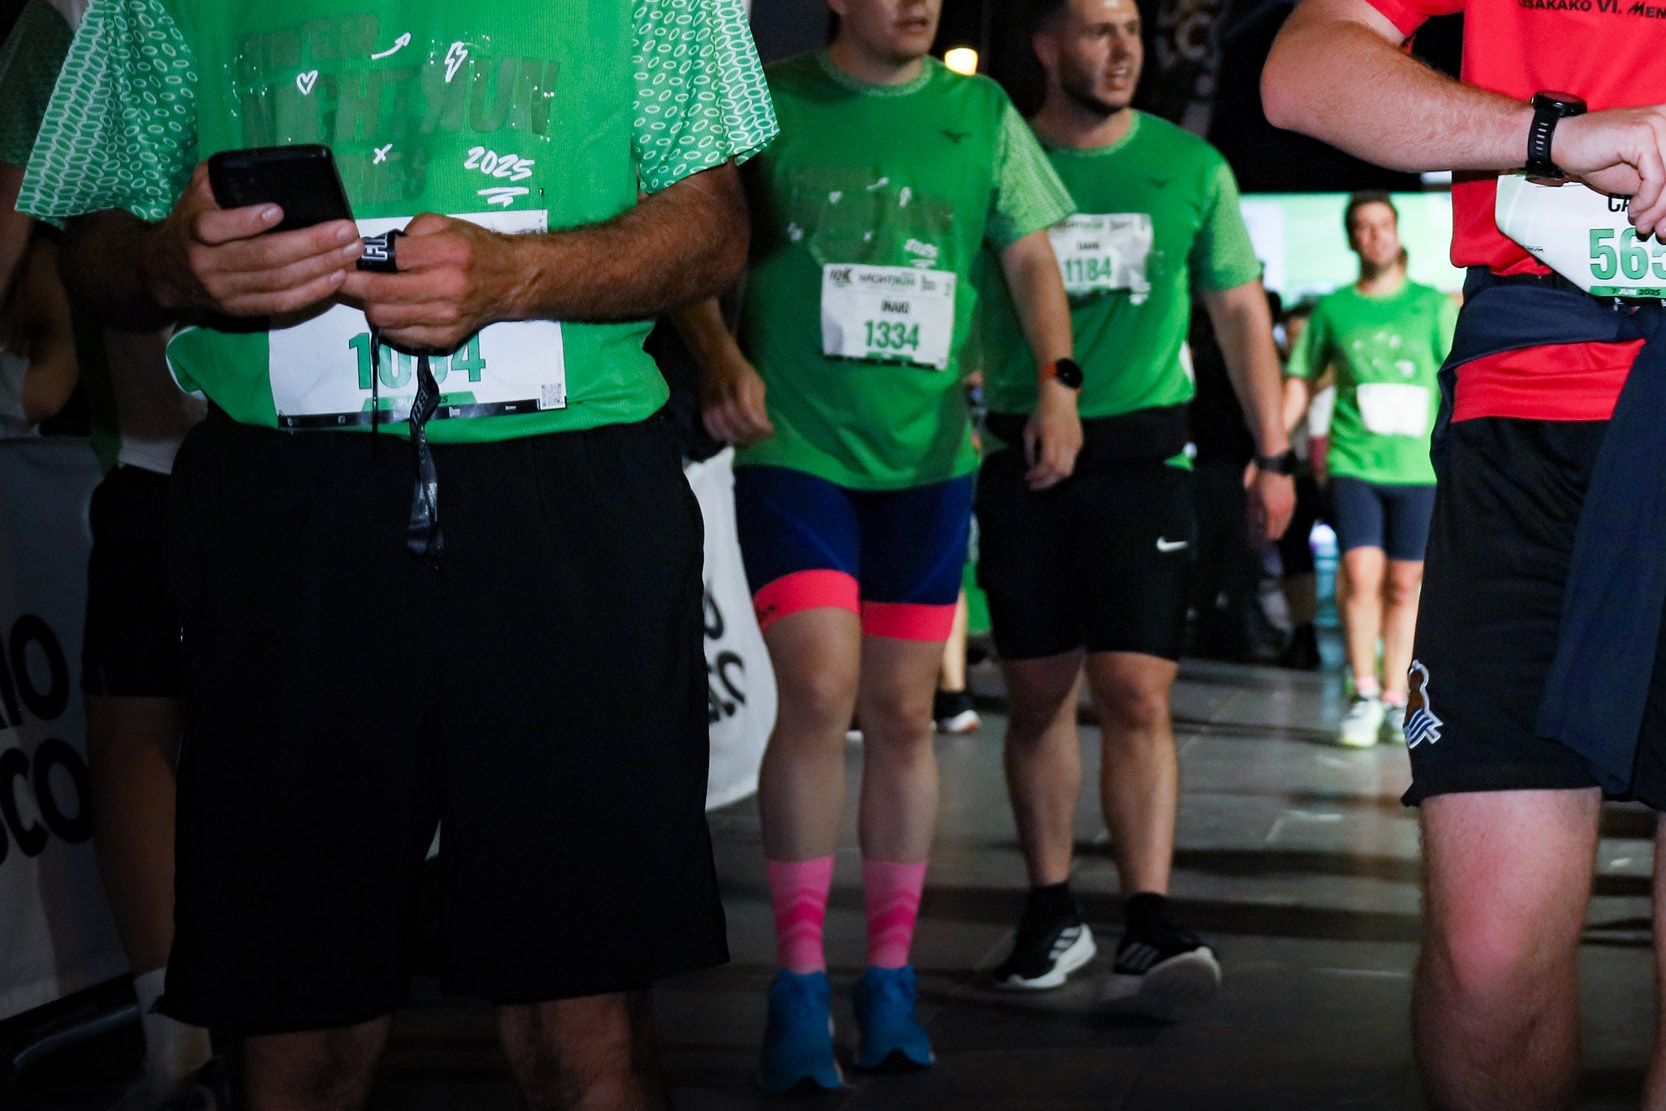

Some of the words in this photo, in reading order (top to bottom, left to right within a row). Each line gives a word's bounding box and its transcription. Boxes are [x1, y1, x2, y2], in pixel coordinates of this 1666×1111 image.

[463, 145, 535, 182] 2025
[1063, 257, 1111, 283] 1184
[1619, 288, 1637, 296] JUN
[1638, 288, 1662, 297] 2025
[864, 320, 920, 350] 1334
